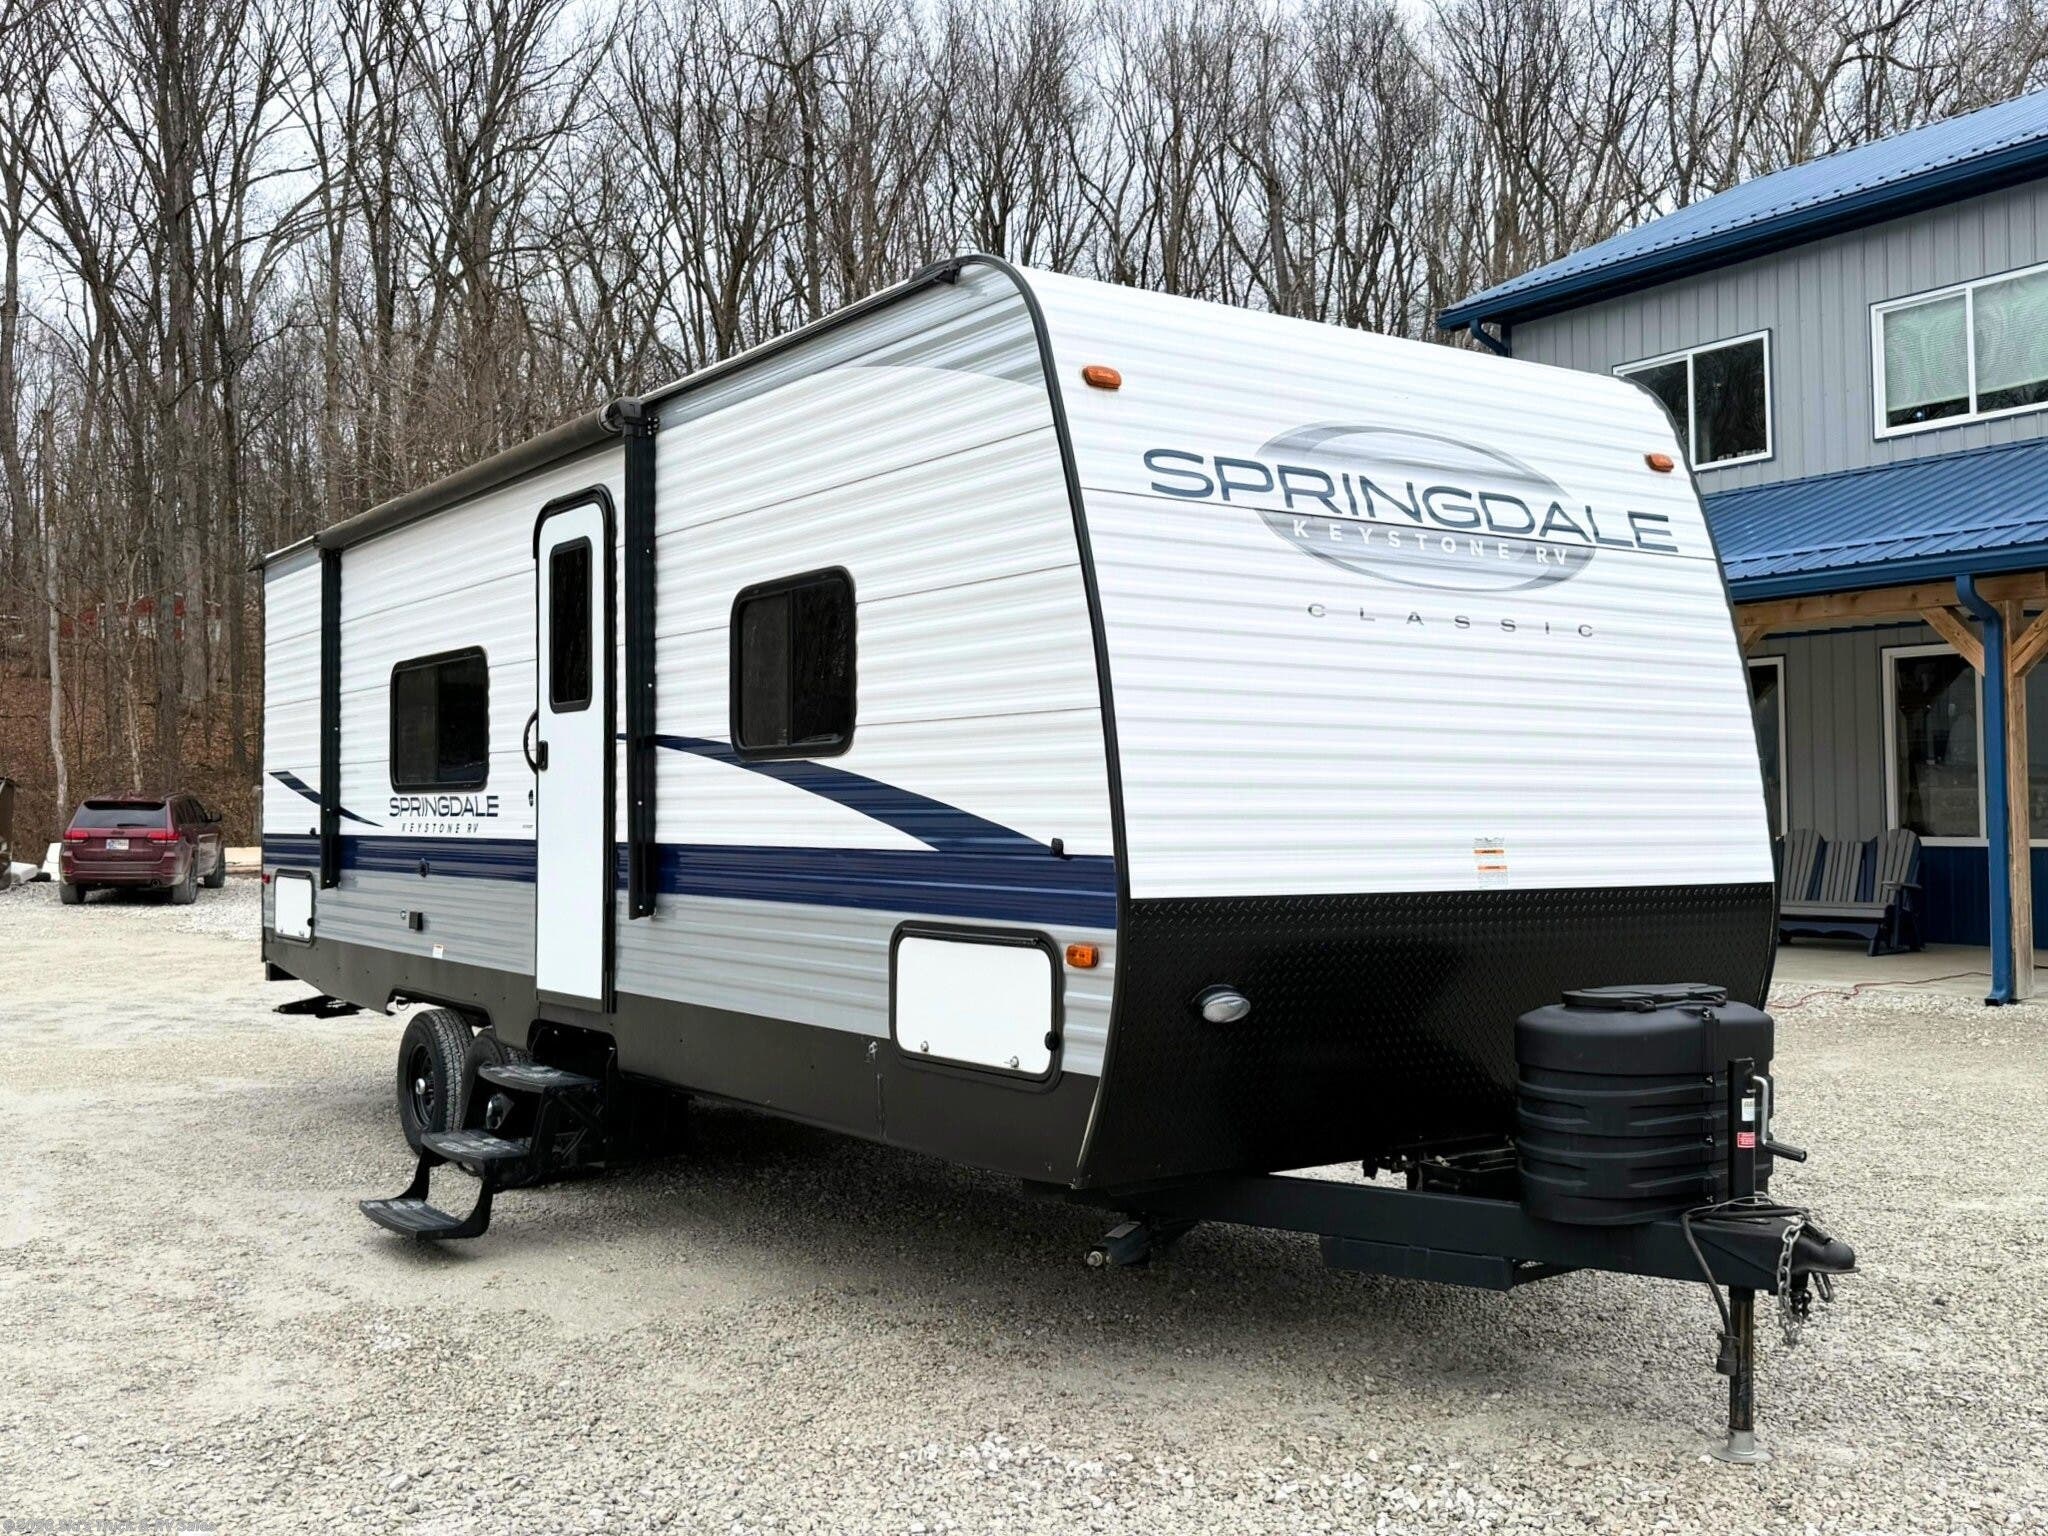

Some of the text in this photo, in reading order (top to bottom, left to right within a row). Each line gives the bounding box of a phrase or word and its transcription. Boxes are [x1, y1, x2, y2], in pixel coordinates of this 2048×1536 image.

[1143, 448, 1679, 553] SPRINGDALE
[1293, 519, 1568, 566] KEYSTONE RV
[1307, 603, 1594, 638] CLASSIC
[389, 795, 499, 818] SPRINGDALE
[401, 823, 479, 834] KEYSTONE RV
